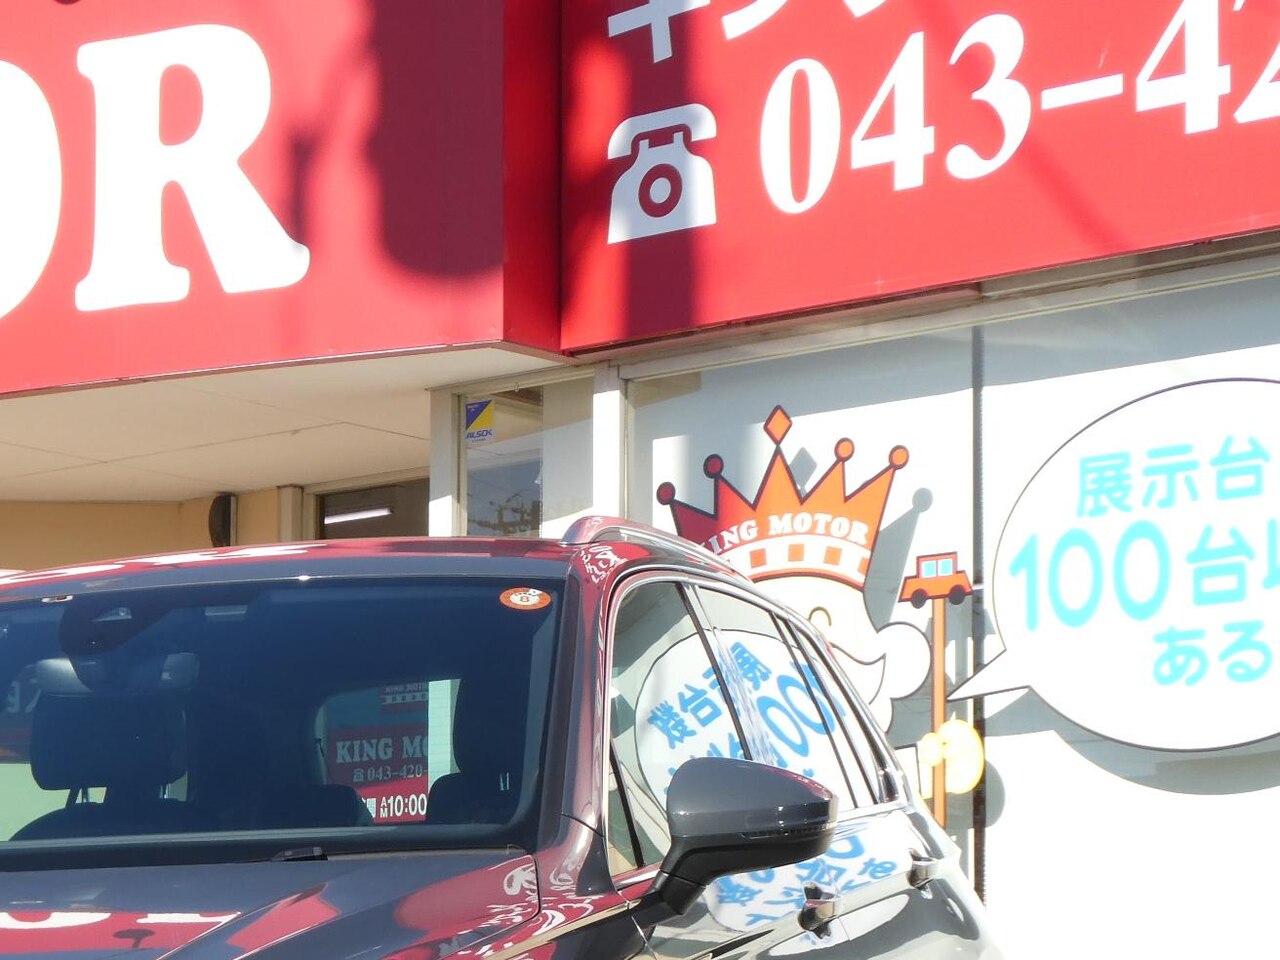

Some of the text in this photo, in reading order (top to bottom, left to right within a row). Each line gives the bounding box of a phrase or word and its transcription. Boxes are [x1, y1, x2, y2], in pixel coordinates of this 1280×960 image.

[466, 429, 493, 440] ALSOK
[1076, 434, 1271, 518] 展示台
[700, 511, 869, 556] ING MOTOR
[1153, 619, 1273, 686] ある
[336, 738, 394, 764] KING
[389, 793, 427, 817] 10:00
